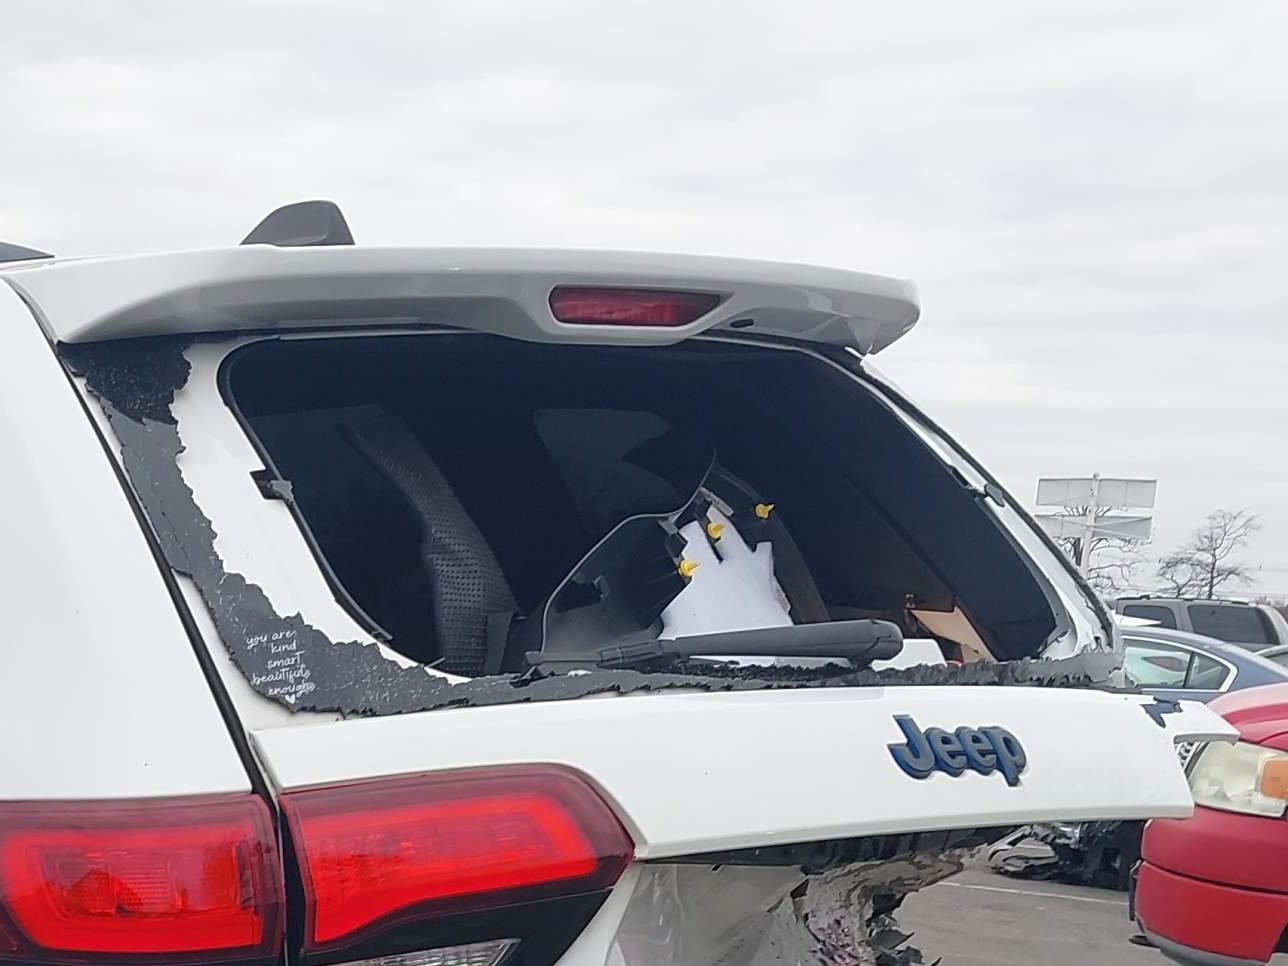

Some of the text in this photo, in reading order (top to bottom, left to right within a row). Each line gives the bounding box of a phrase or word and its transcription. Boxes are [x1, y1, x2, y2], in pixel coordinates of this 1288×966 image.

[245, 630, 297, 650] you are
[270, 640, 297, 654] kind
[267, 651, 305, 670] smart
[251, 664, 311, 685] beautiful
[268, 681, 316, 698] enough
[887, 714, 1028, 787] Jeep
